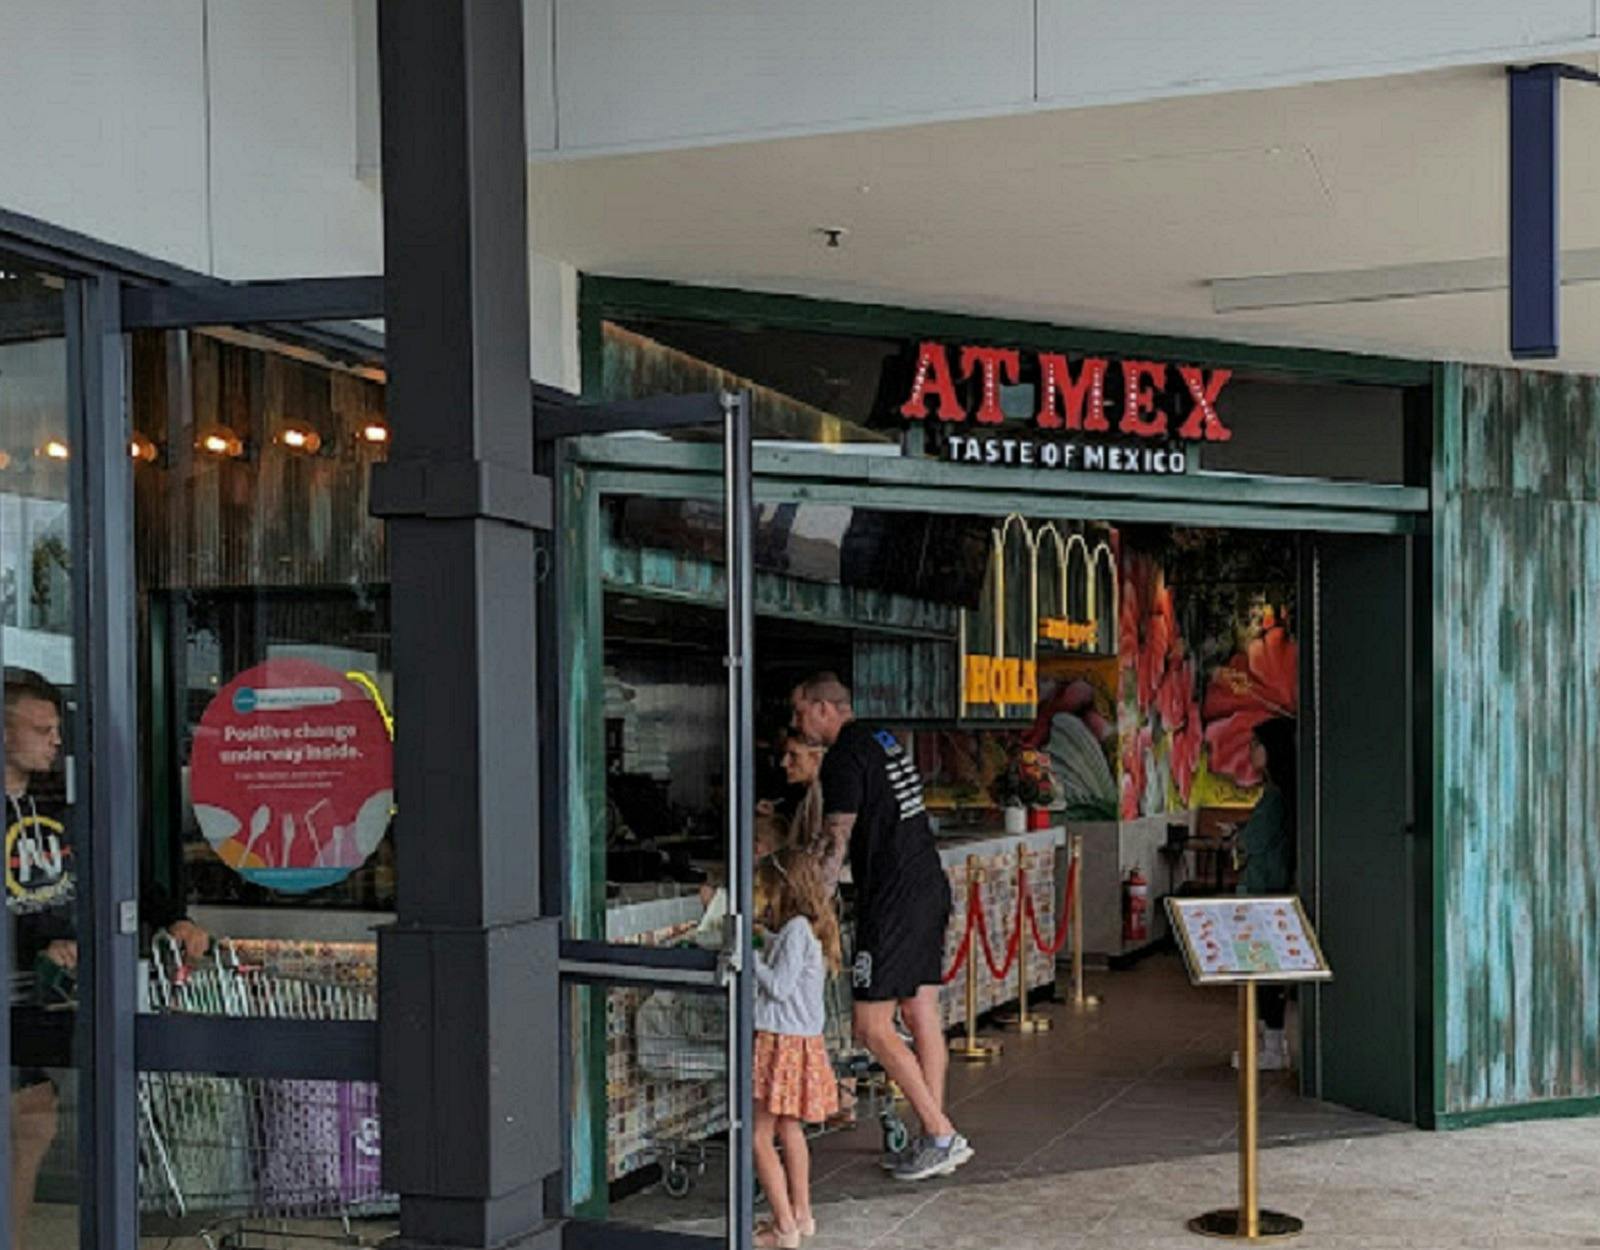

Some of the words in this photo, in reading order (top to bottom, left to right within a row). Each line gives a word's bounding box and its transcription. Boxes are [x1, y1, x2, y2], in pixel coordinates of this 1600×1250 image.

[949, 436, 1034, 464] TASTE
[1041, 443, 1075, 467] OF
[1084, 445, 1186, 473] MEXICO
[223, 724, 291, 742] Positive
[294, 722, 357, 742] change
[219, 745, 303, 765] underway
